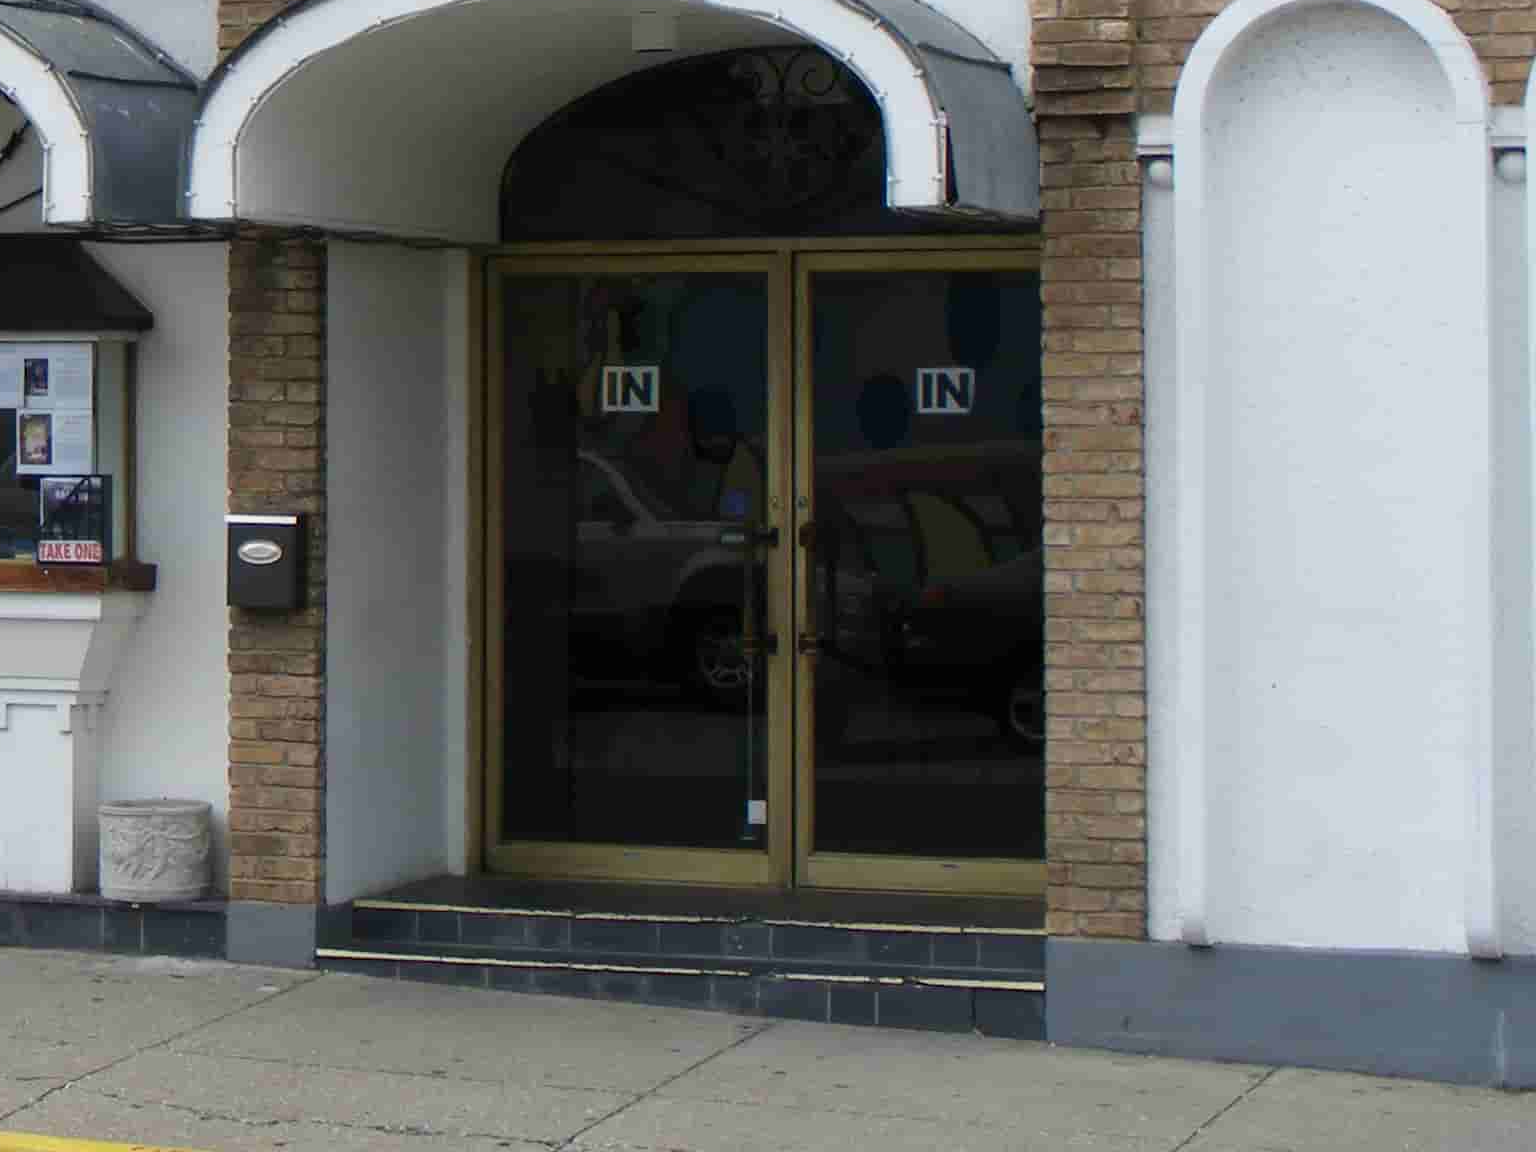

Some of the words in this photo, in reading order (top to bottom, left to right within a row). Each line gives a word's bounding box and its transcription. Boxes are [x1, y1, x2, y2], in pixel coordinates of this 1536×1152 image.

[607, 370, 653, 406] IN
[921, 371, 970, 408] IN
[40, 543, 71, 559] TAKE
[74, 543, 102, 560] ONE
